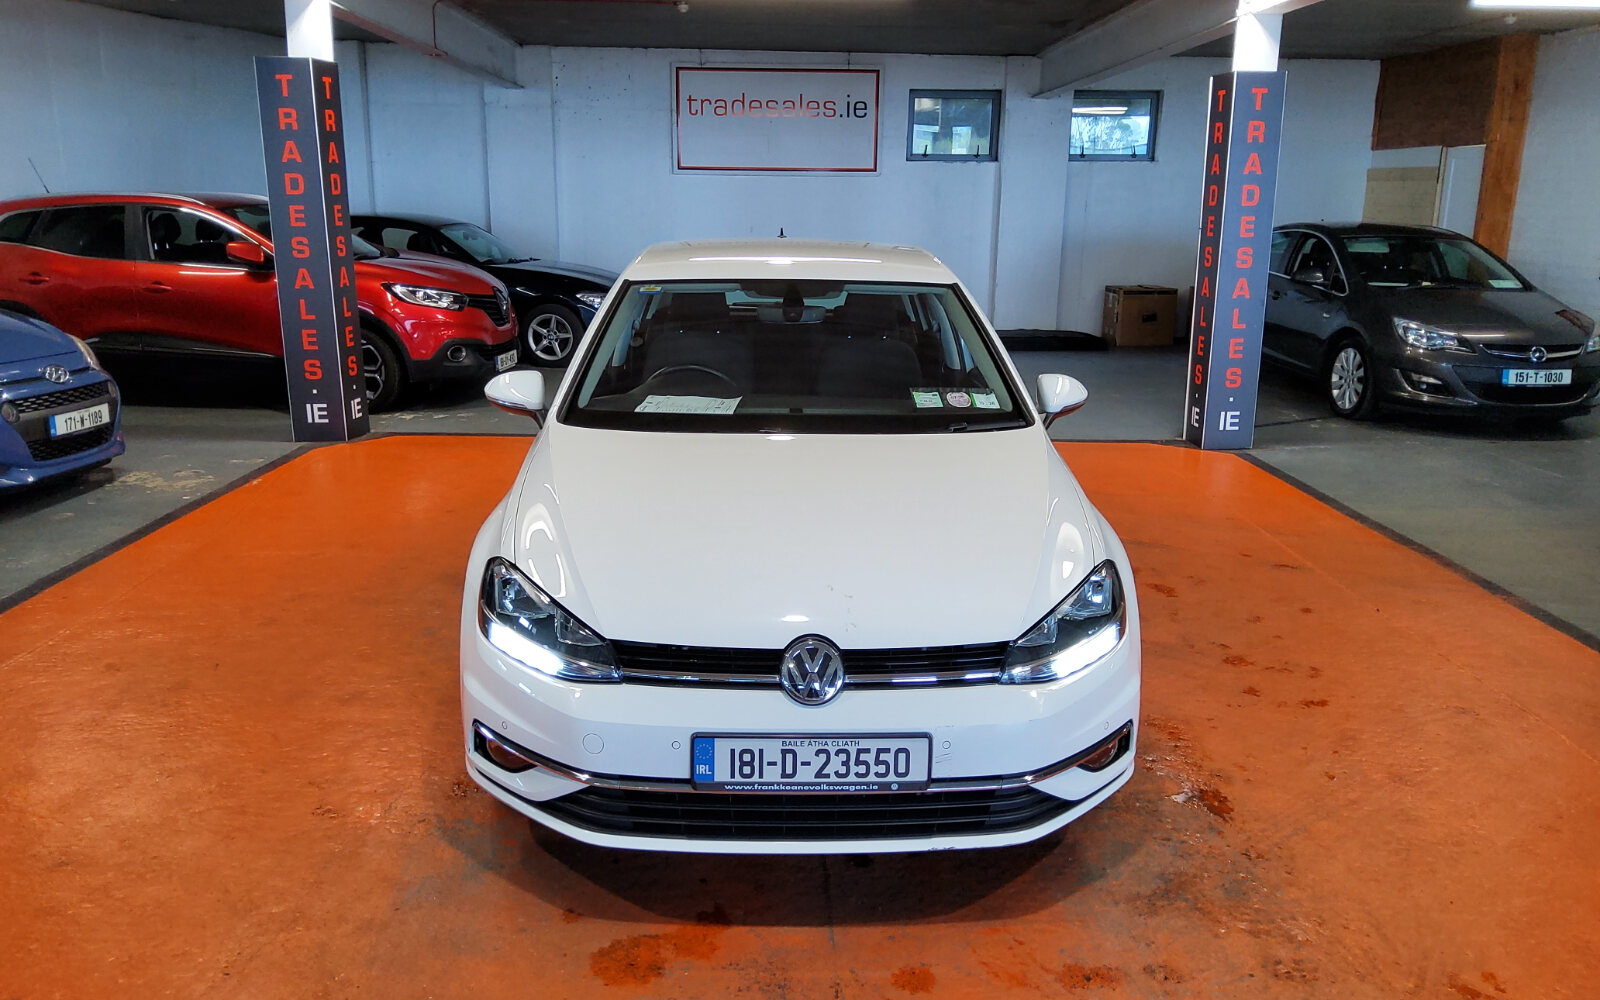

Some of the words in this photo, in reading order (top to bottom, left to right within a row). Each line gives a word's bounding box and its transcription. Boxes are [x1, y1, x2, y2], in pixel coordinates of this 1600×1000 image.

[687, 92, 868, 119] tradesales.ie
[1514, 371, 1564, 383] 151-T-1030
[64, 409, 103, 431] 171-W-1189
[696, 764, 712, 775] IRL
[730, 747, 911, 779] 181-D-23550
